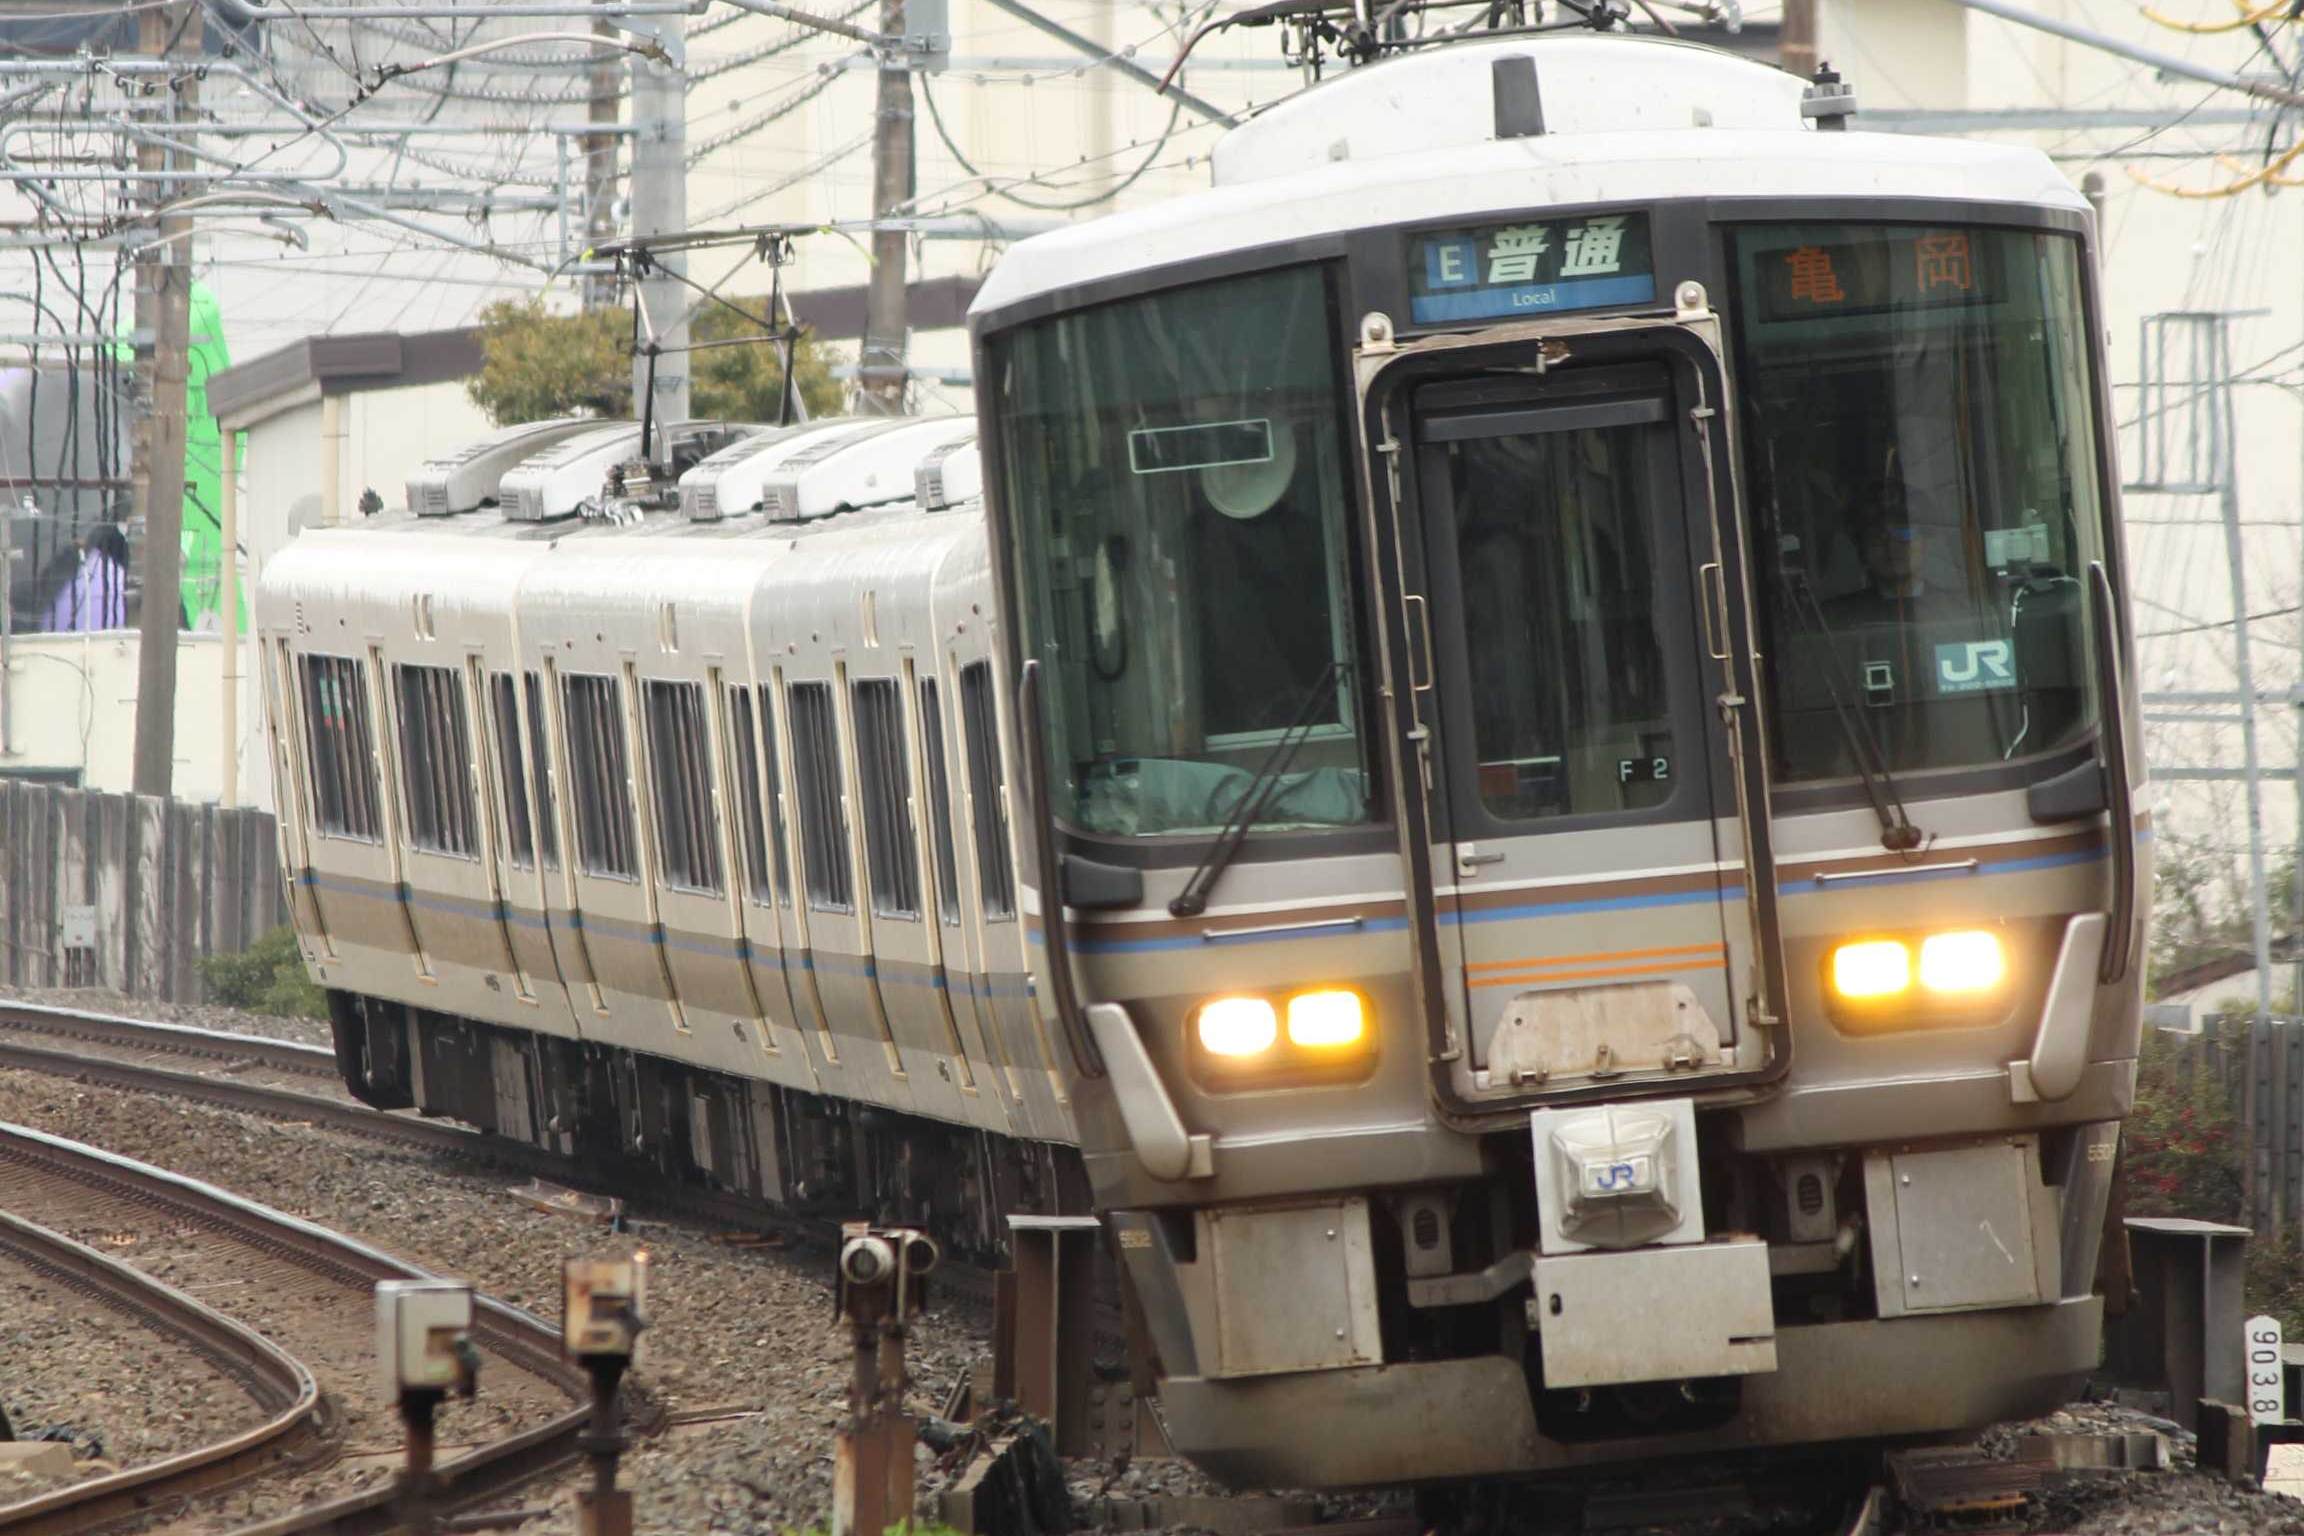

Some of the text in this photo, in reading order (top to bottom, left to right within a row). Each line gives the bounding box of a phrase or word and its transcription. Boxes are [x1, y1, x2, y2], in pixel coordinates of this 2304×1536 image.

[1439, 245, 1465, 282] E
[1488, 216, 1627, 283] 普通
[1512, 288, 1556, 307] Local
[1941, 639, 2011, 682] JR
[1620, 757, 1668, 782] F 2
[1597, 1165, 1633, 1189] JR
